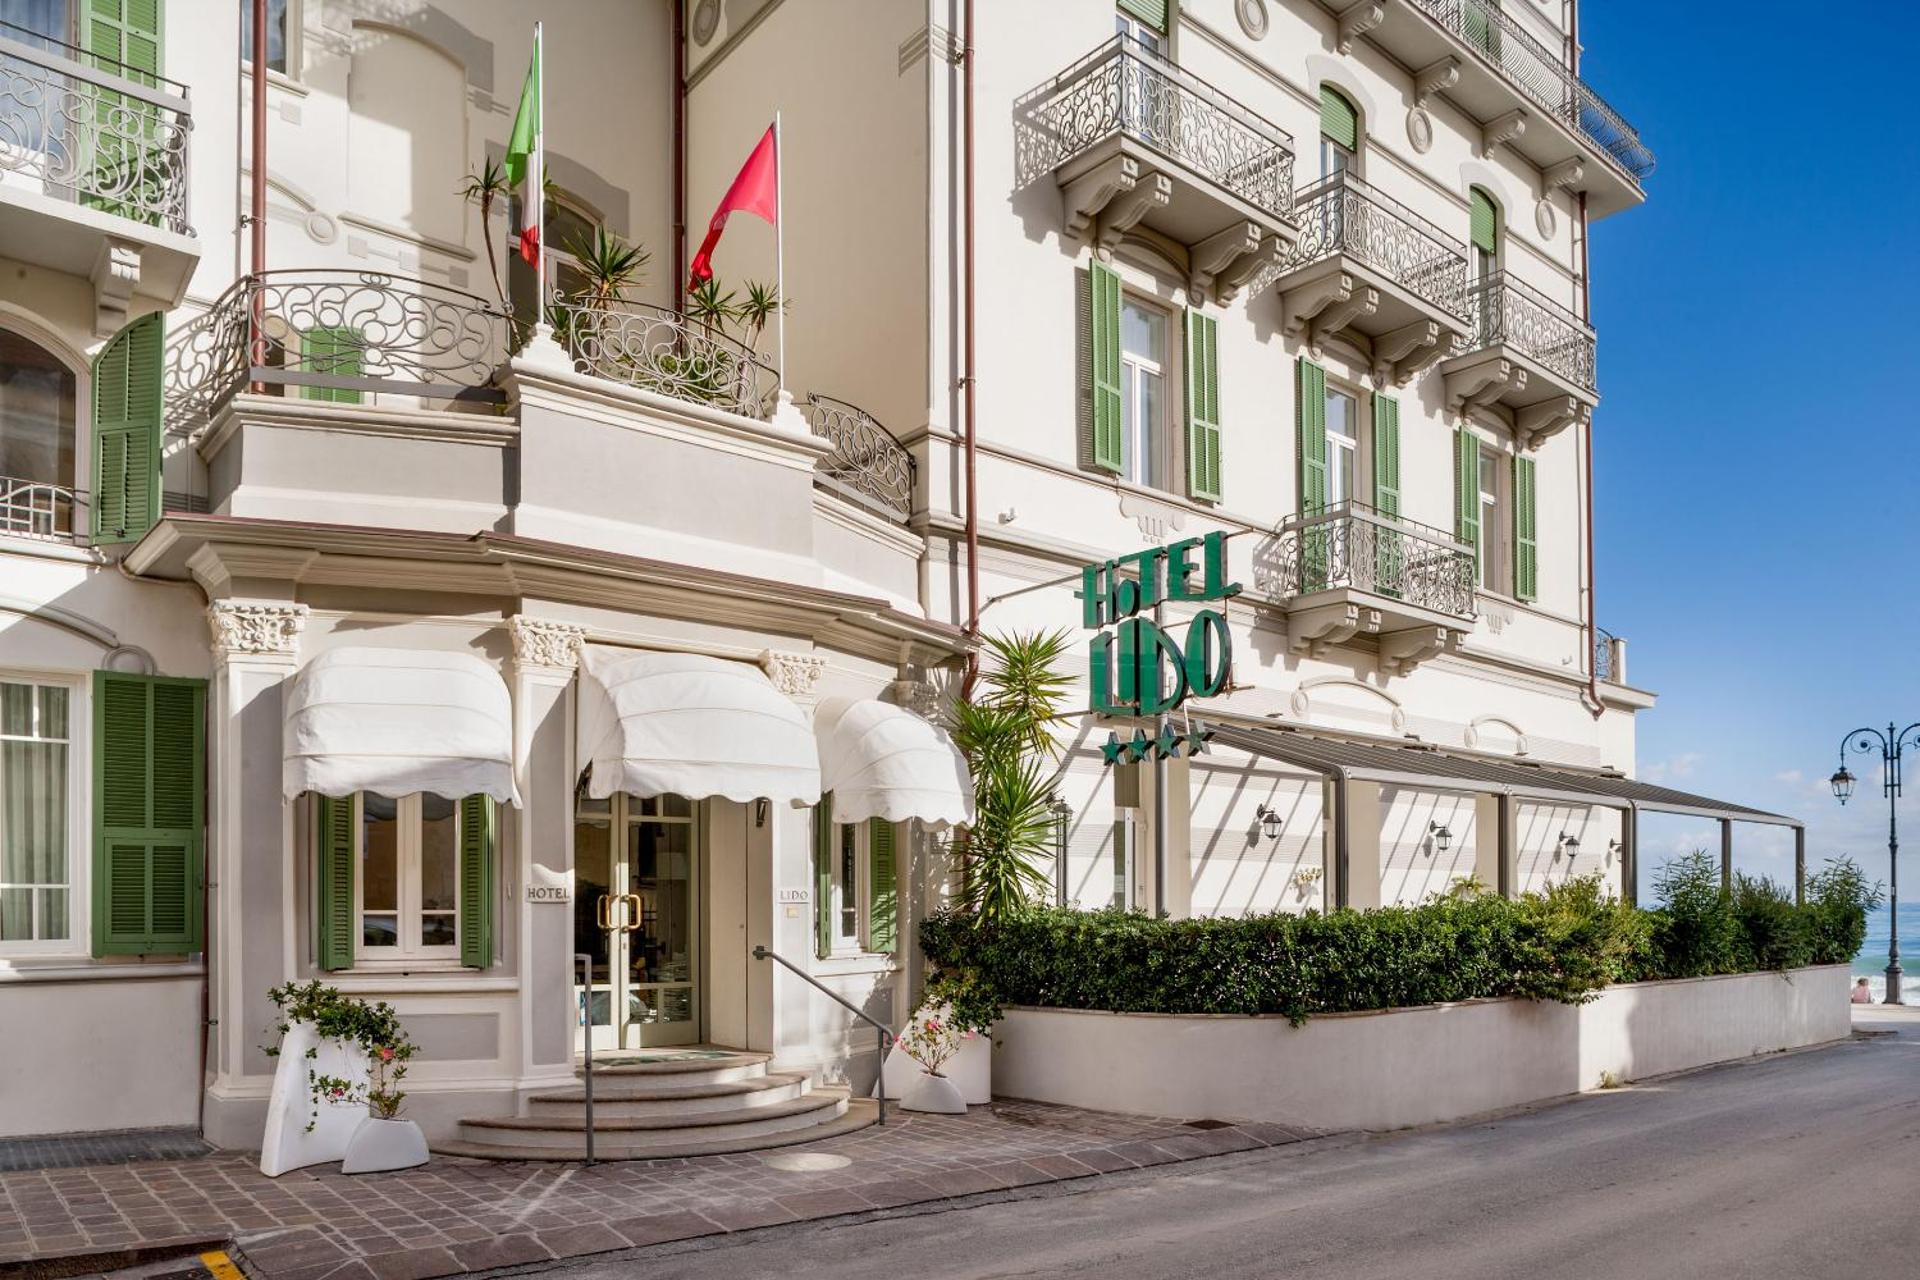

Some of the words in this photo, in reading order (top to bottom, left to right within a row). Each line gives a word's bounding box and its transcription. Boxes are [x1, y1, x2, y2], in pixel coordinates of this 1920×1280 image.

[1074, 531, 1243, 629] HOTEL
[1089, 609, 1232, 717] LIDO
[527, 887, 571, 900] HOTEL
[780, 889, 809, 901] LIDO
